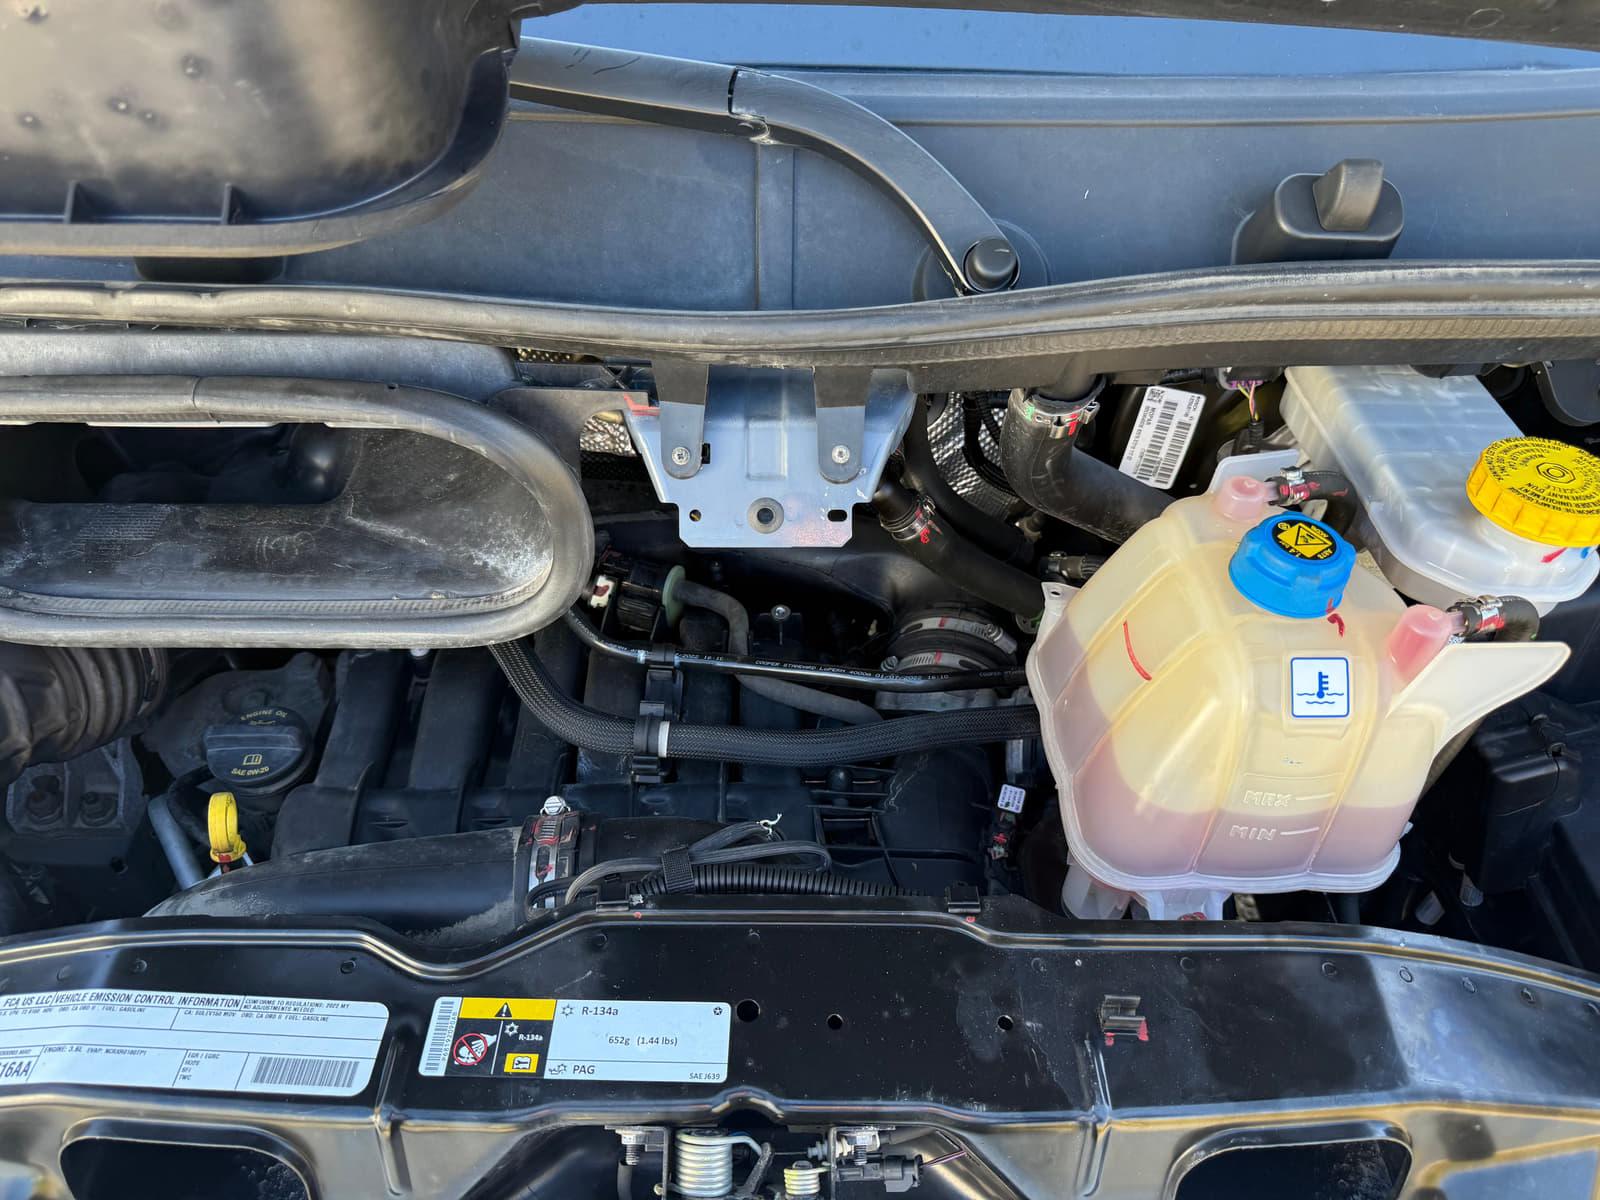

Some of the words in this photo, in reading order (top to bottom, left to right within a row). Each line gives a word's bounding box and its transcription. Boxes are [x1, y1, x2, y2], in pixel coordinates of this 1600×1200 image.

[240, 709, 273, 721] ENGINE
[1229, 824, 1277, 841] MIN
[3, 998, 21, 1008] FCA
[21, 995, 35, 1006] US
[35, 994, 53, 1005] LLC
[56, 992, 88, 1003] VEHICLE
[89, 992, 132, 1003] EMISSION
[134, 993, 175, 1005] CONTROL
[177, 996, 241, 1008] INFORMATION
[581, 1006, 619, 1016] R-134a
[518, 1033, 543, 1041] R-134a
[608, 1036, 631, 1046] 652g
[636, 1036, 660, 1046] (1.44
[661, 1036, 678, 1047] lbs)
[572, 1064, 596, 1075] PAG
[689, 1072, 703, 1080] SAE
